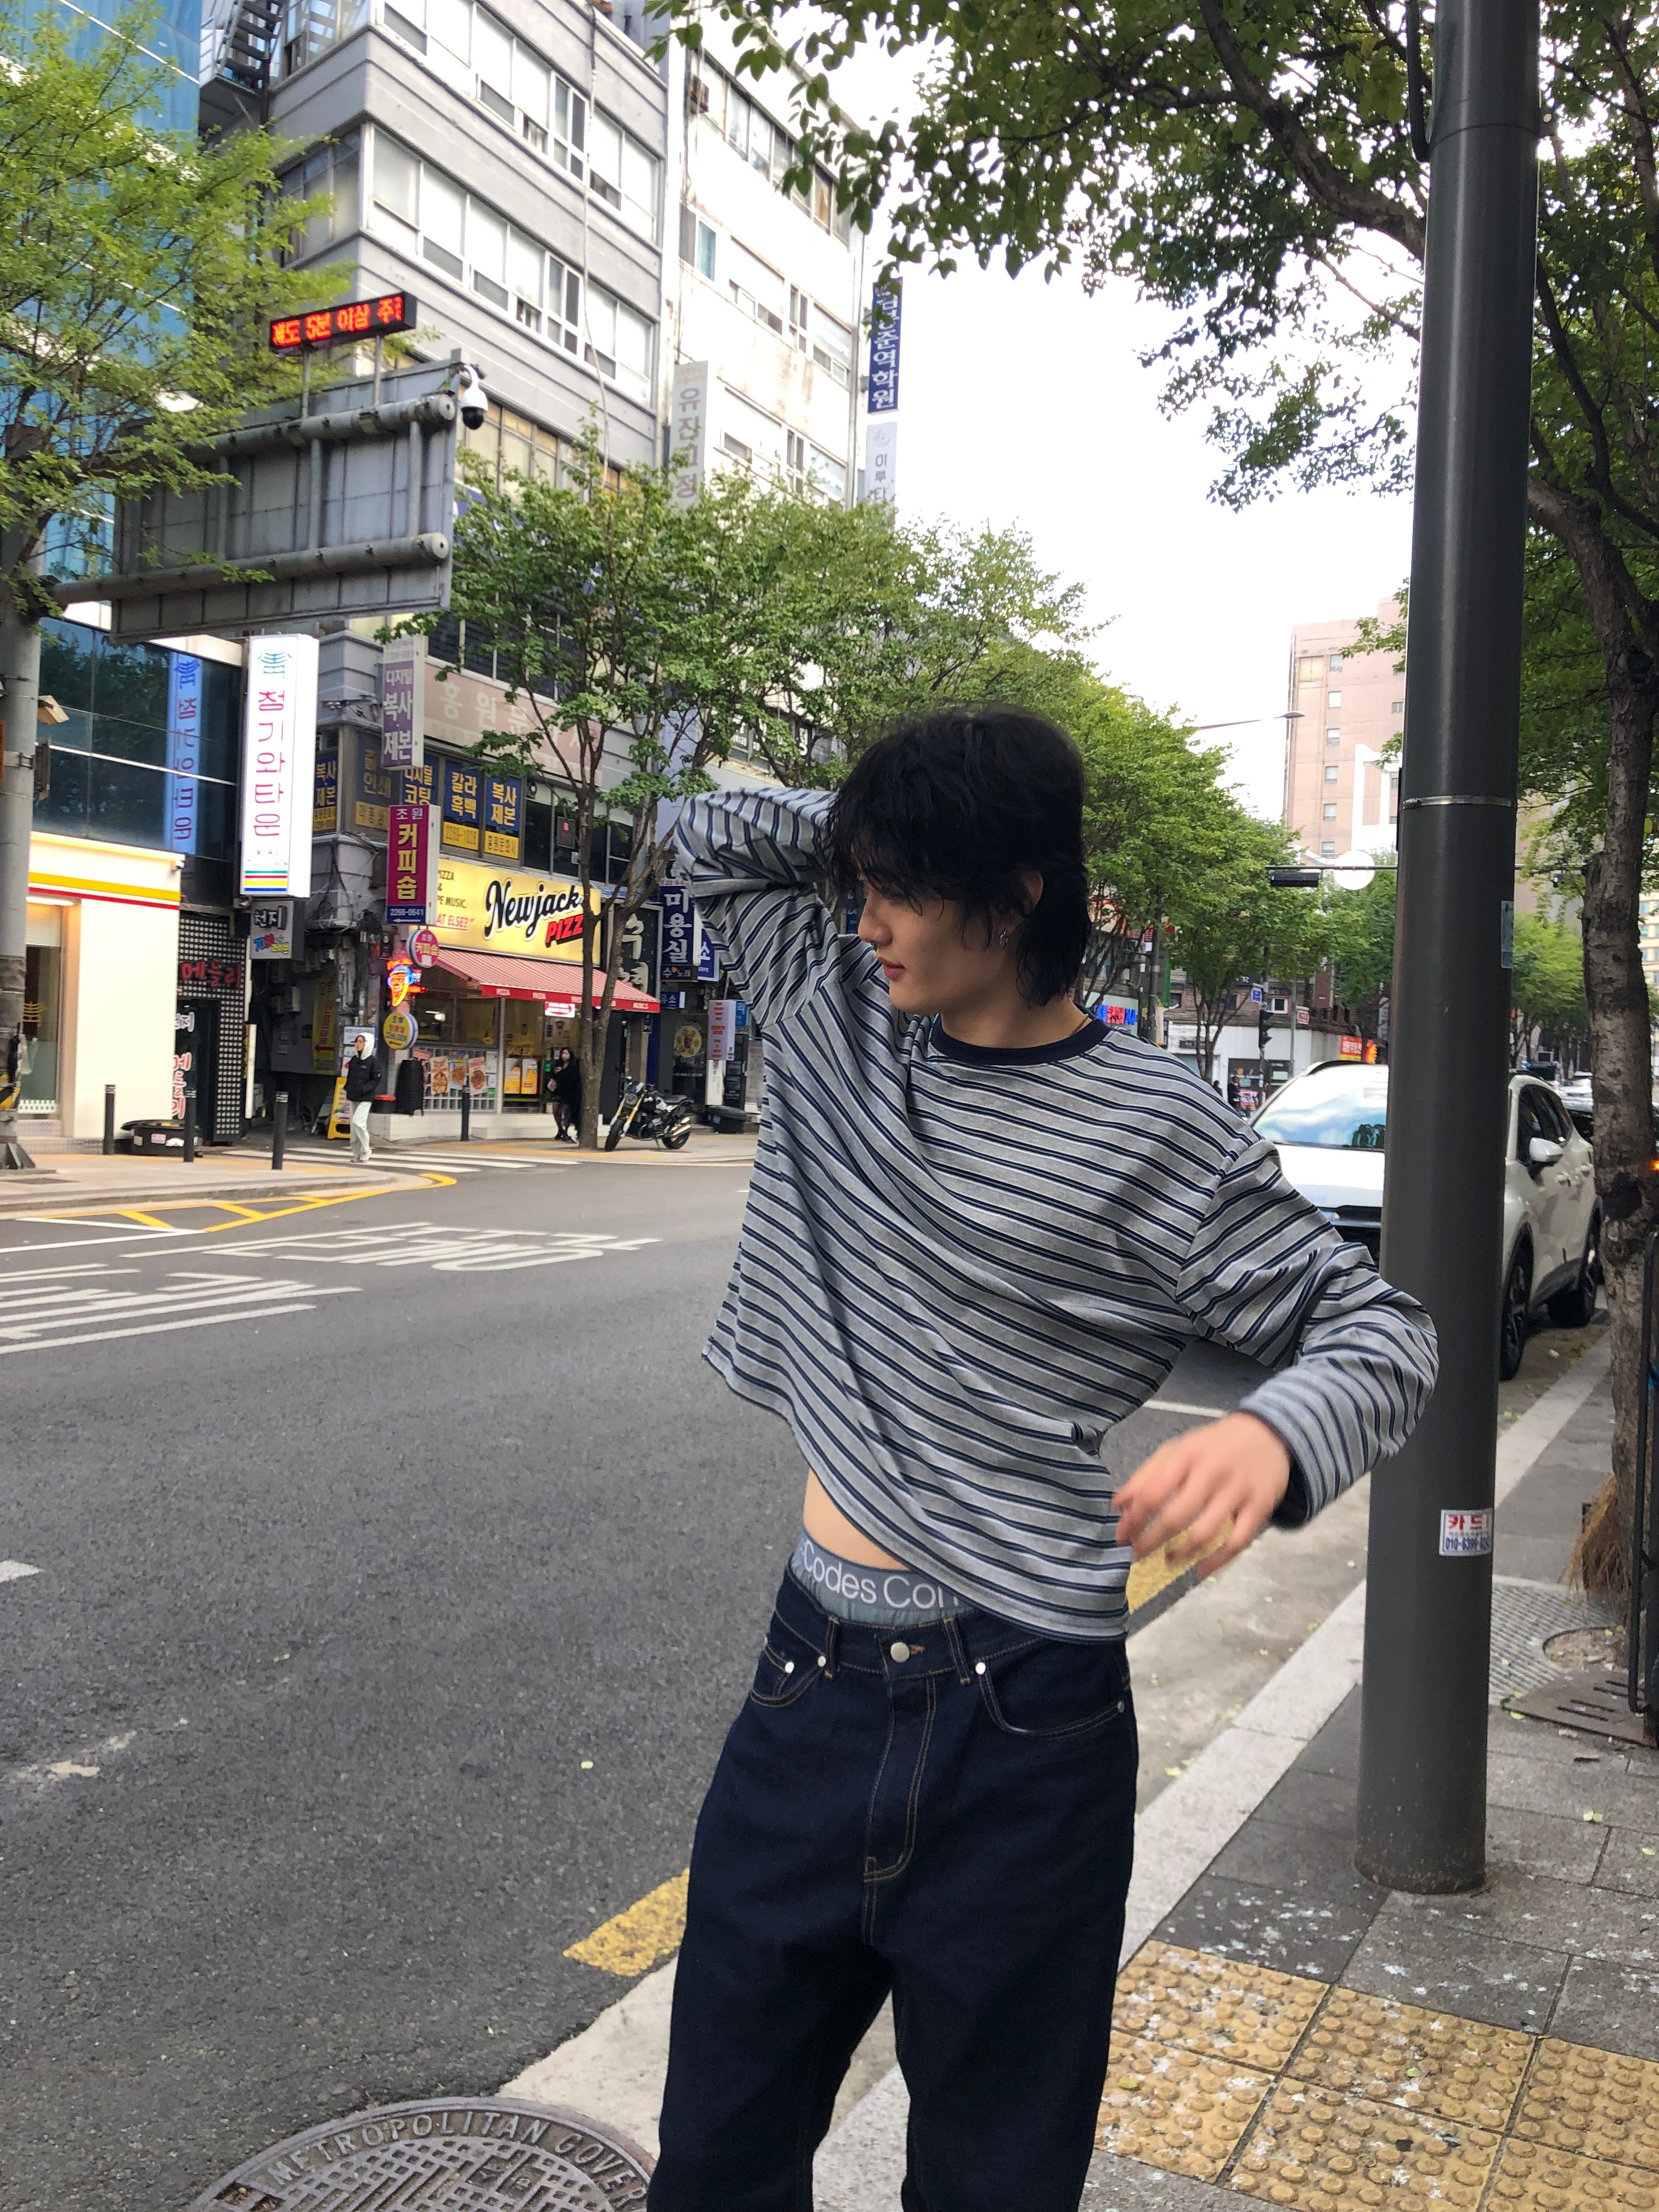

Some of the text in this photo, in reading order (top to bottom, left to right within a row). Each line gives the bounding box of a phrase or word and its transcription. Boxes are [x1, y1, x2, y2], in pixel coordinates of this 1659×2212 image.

[306, 312, 331, 340] 5분
[336, 304, 370, 331] 이상
[386, 669, 413, 686] 디지털
[385, 690, 413, 721] 복사
[384, 730, 411, 760] 제본
[253, 690, 286, 837] 청기와타운
[316, 760, 336, 781] 복사
[405, 783, 431, 805] 코팅
[452, 771, 477, 797] 칼라
[492, 782, 517, 807] 복사
[396, 808, 424, 820] 조원
[451, 795, 476, 820] 흑백
[491, 803, 516, 827] 제본
[397, 823, 417, 900] 커피숍
[484, 879, 582, 938] Newjack
[545, 913, 584, 946] PIZZ
[663, 889, 692, 963] 미용실
[415, 943, 438, 956] 커피숍
[180, 957, 242, 988] 메들리
[803, 1540, 877, 1604] Codes
[266, 2110, 647, 2209] METROPOLITAN COVER
